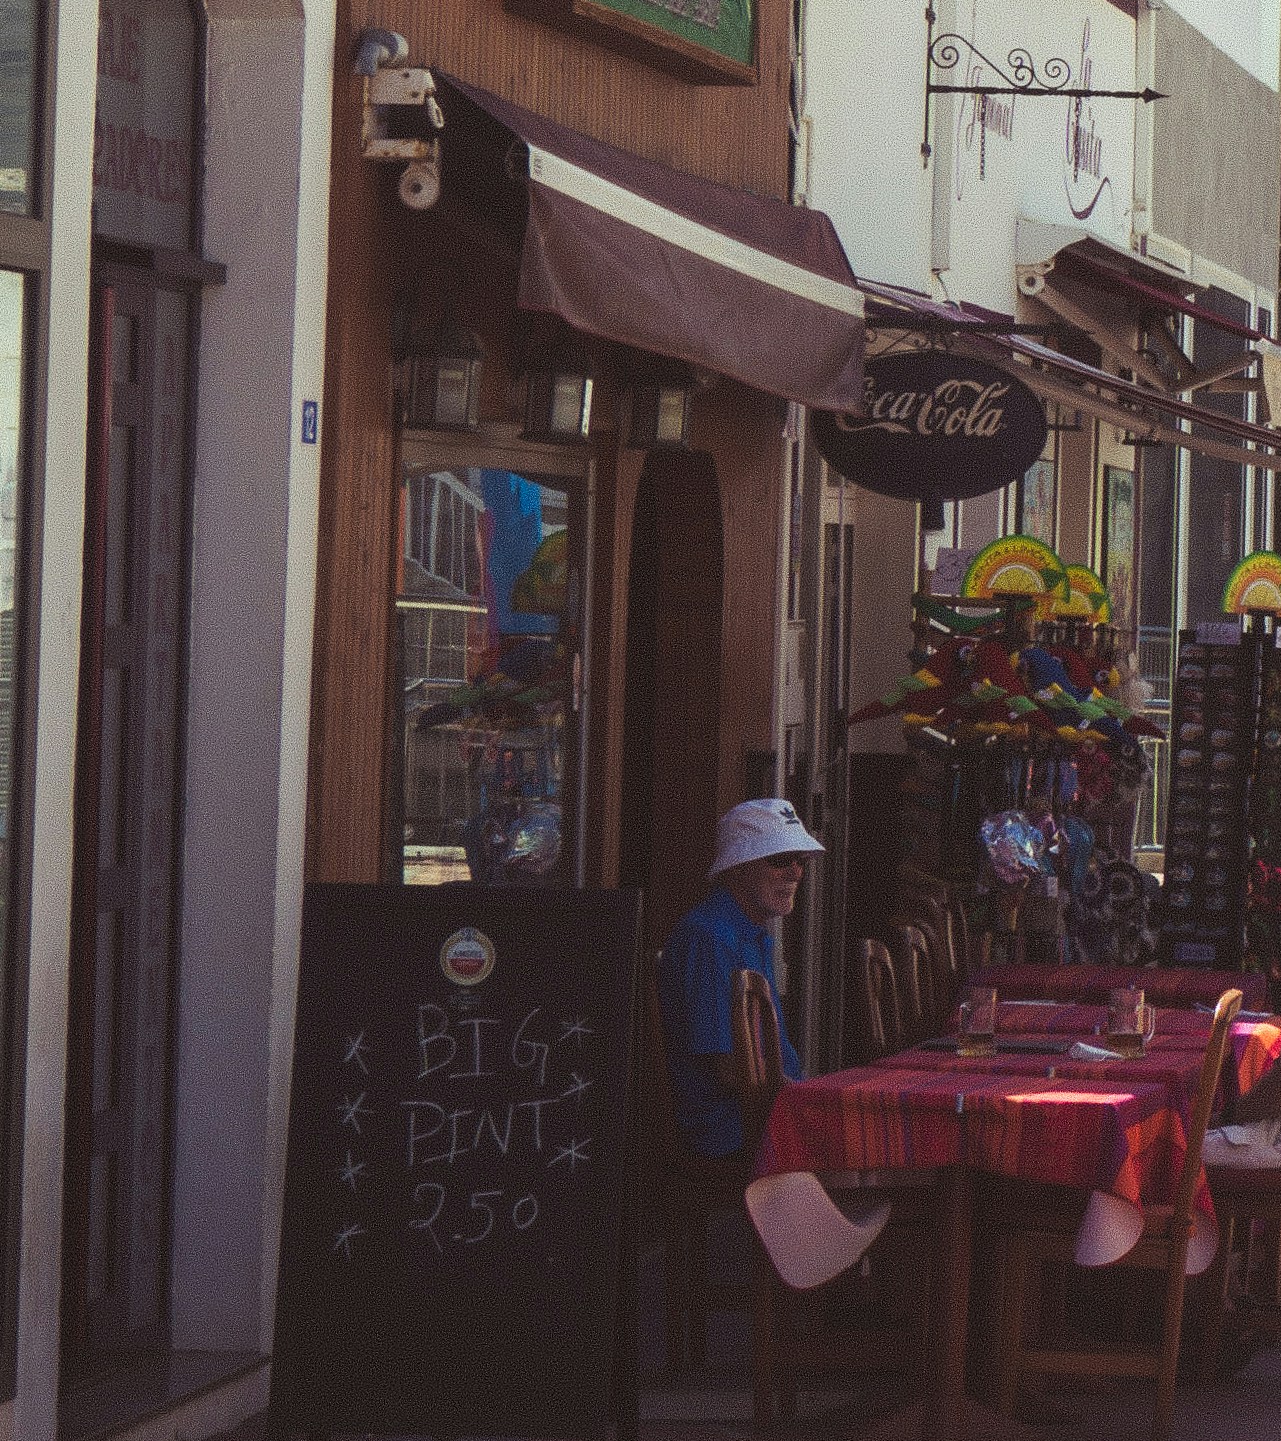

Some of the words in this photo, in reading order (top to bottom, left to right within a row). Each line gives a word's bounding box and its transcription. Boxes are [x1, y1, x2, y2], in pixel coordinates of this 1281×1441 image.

[417, 1003, 550, 1087] BIG
[400, 1098, 561, 1168] PINT
[408, 1181, 539, 1253] 2.50
